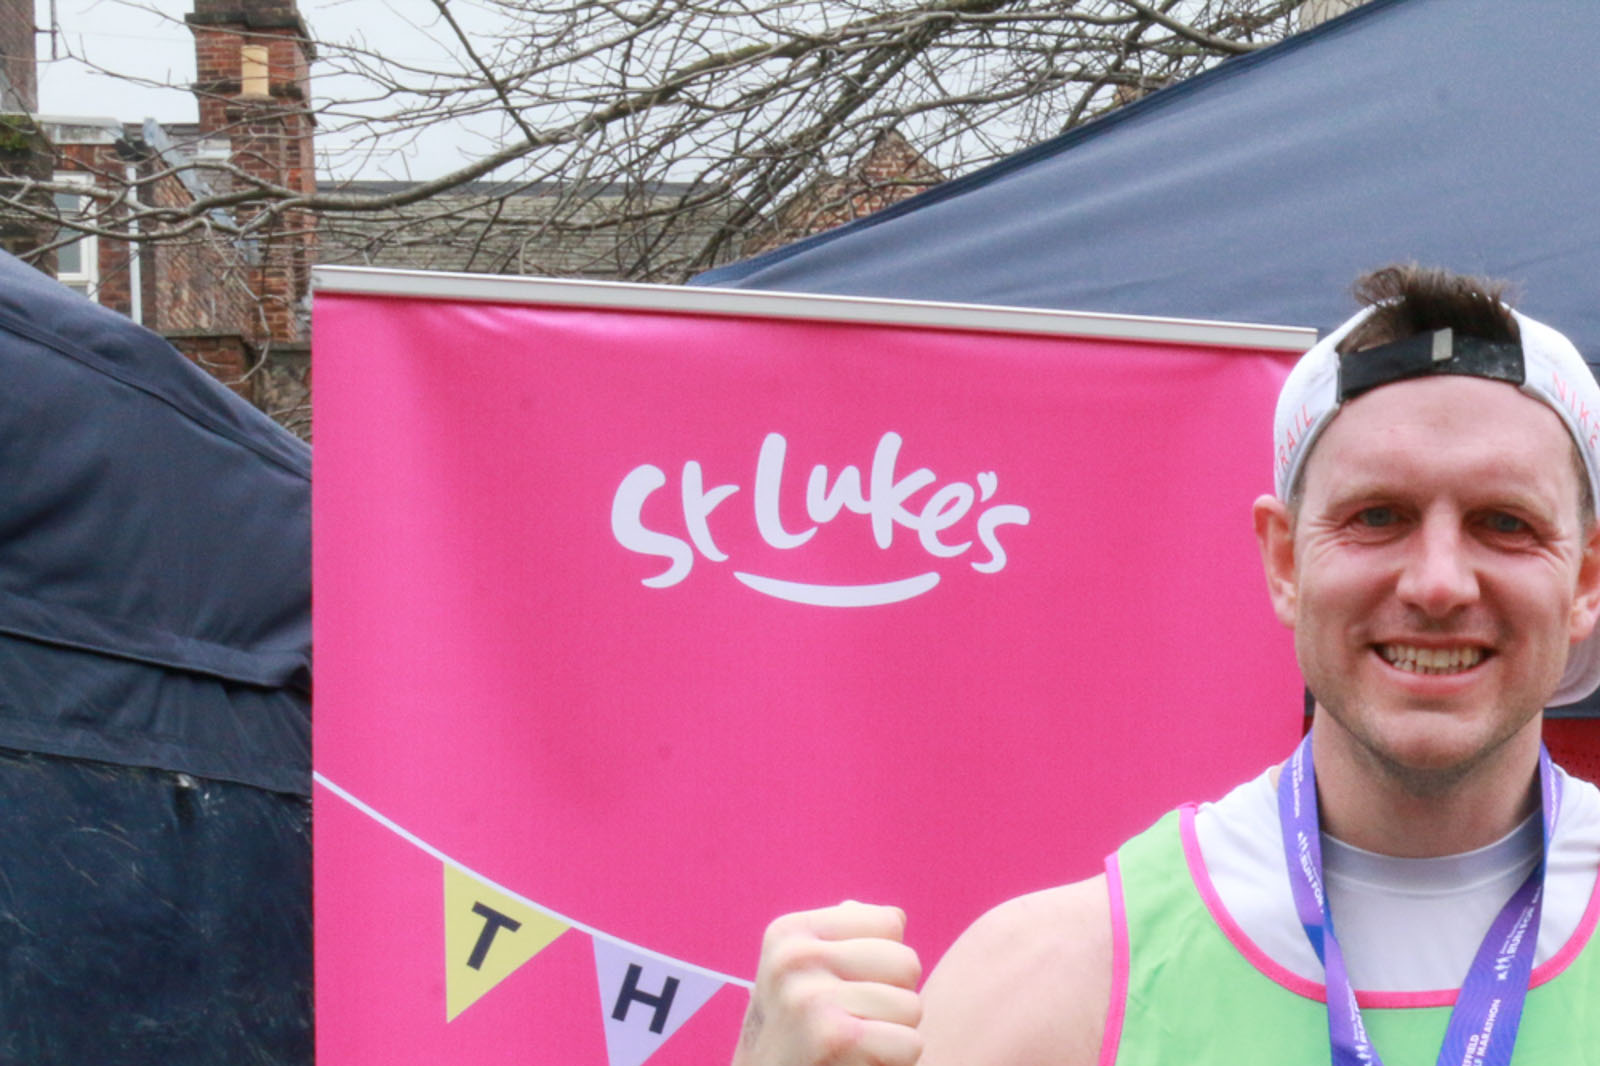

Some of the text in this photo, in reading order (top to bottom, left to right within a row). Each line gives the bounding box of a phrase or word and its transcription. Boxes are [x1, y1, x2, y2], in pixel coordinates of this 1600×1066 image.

[611, 431, 1031, 589] St Luke's
[1477, 999, 1502, 1057] MARATHON
